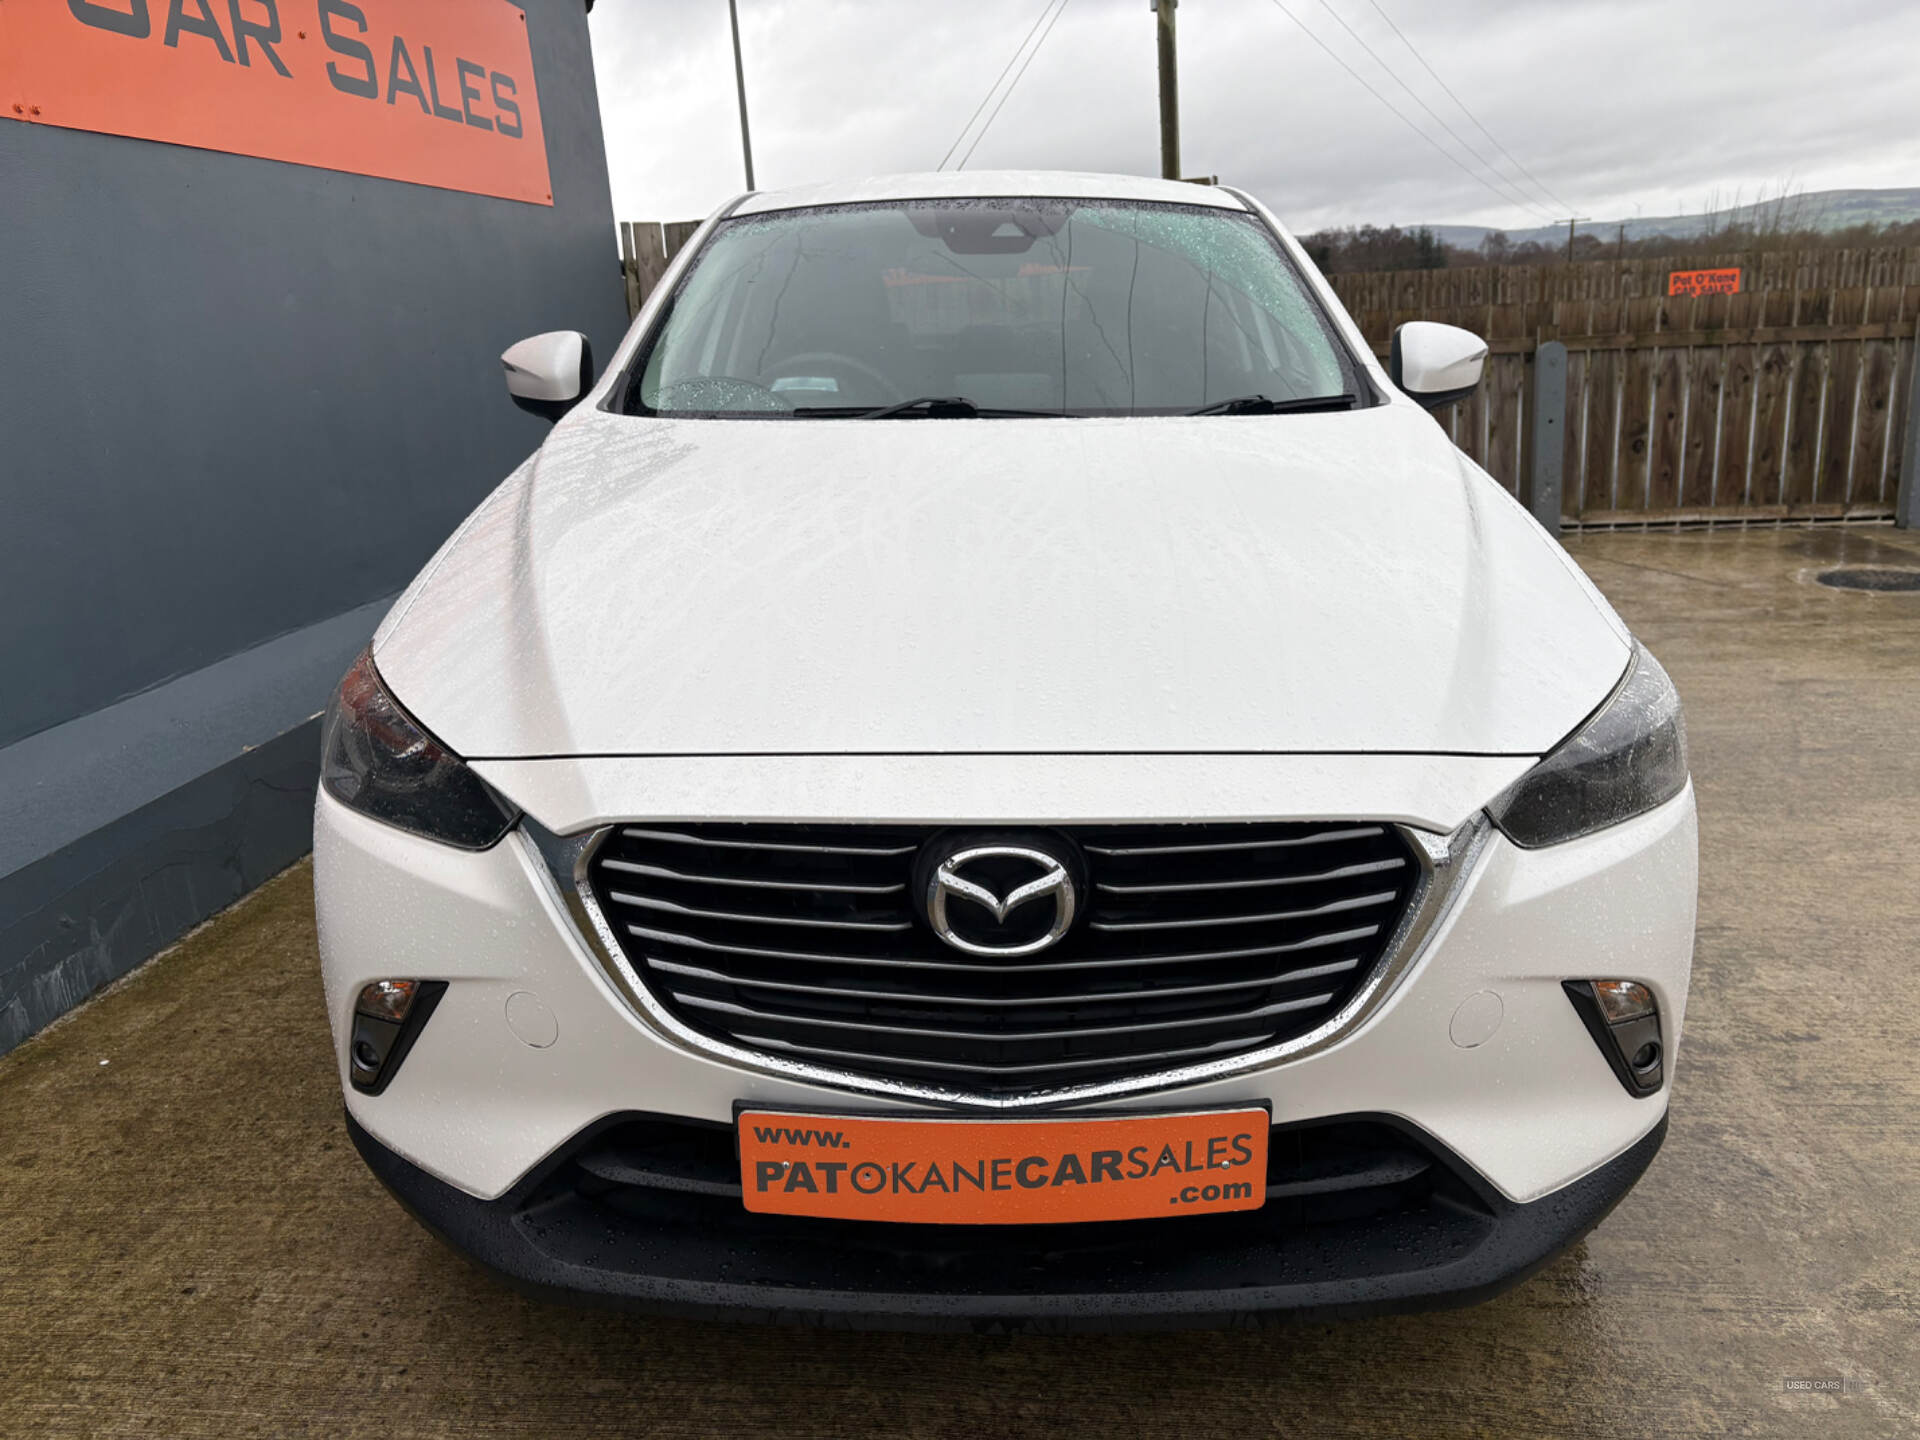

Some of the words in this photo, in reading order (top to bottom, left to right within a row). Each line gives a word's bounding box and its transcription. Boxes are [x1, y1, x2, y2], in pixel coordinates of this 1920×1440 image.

[317, 0, 523, 139] SALES
[754, 1126, 850, 1149] www.
[755, 1133, 1253, 1194] PATOKANECARSALES
[1169, 1179, 1252, 1204] .com
